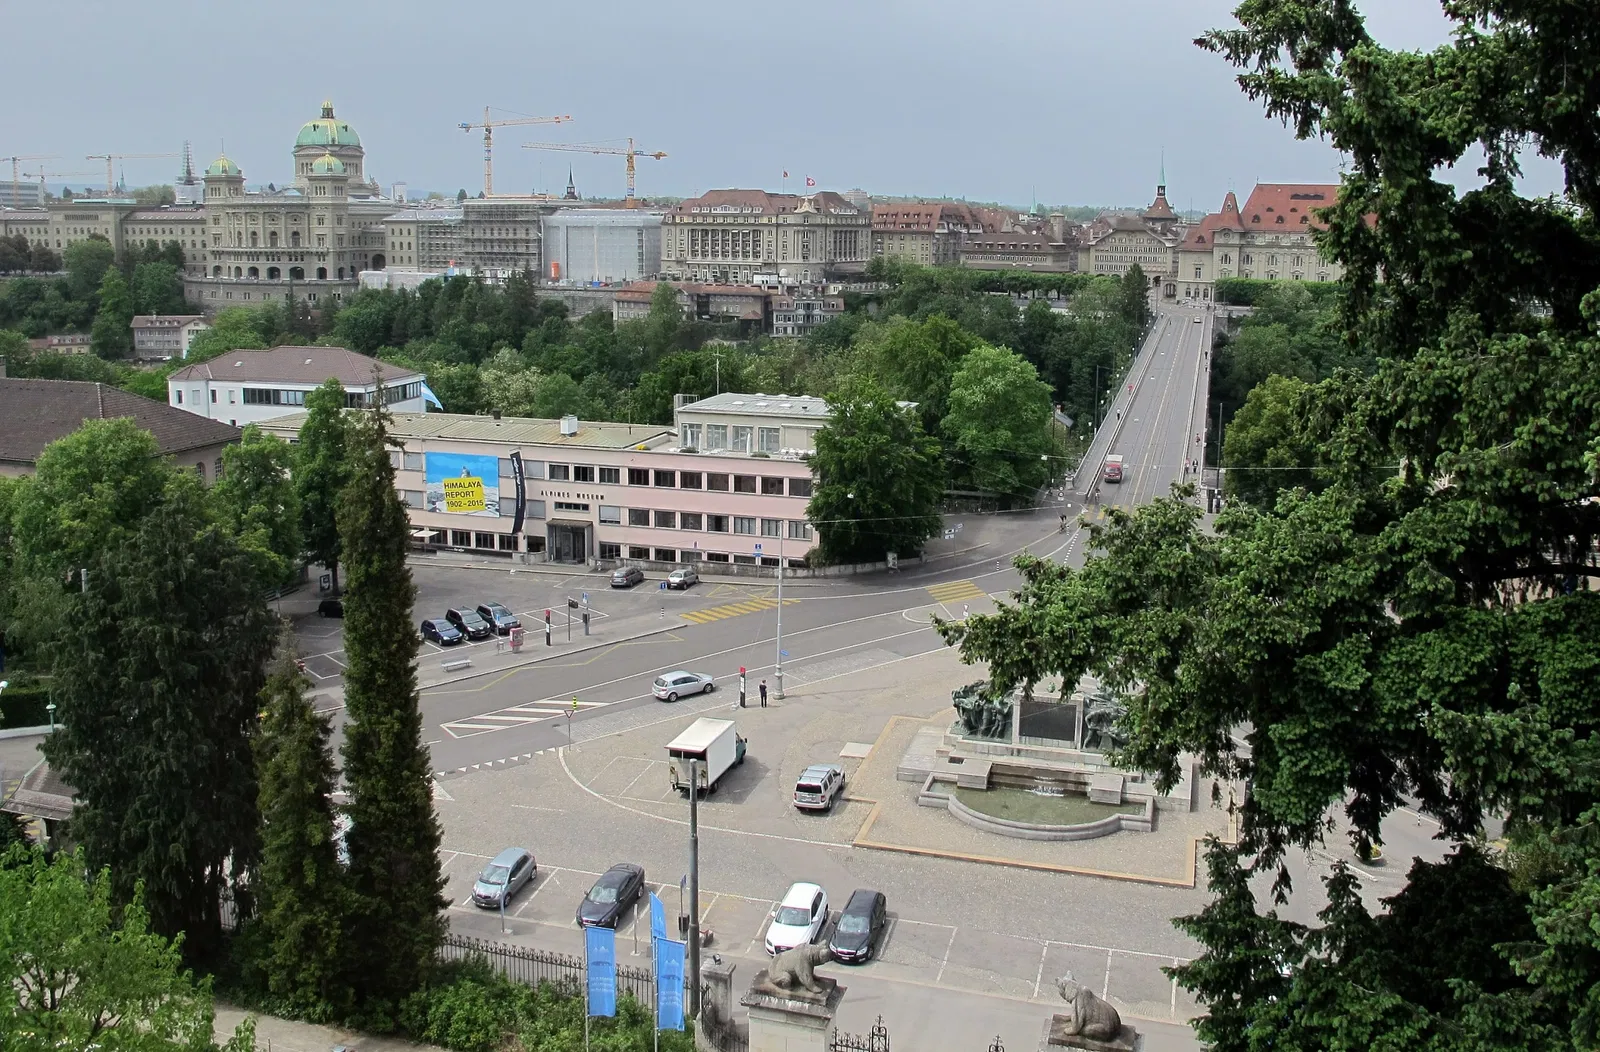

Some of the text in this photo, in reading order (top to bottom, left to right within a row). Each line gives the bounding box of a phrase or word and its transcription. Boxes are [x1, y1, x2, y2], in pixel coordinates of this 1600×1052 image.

[444, 481, 482, 489] HIMALAYA
[540, 490, 605, 500] ALPINES MUSEUM
